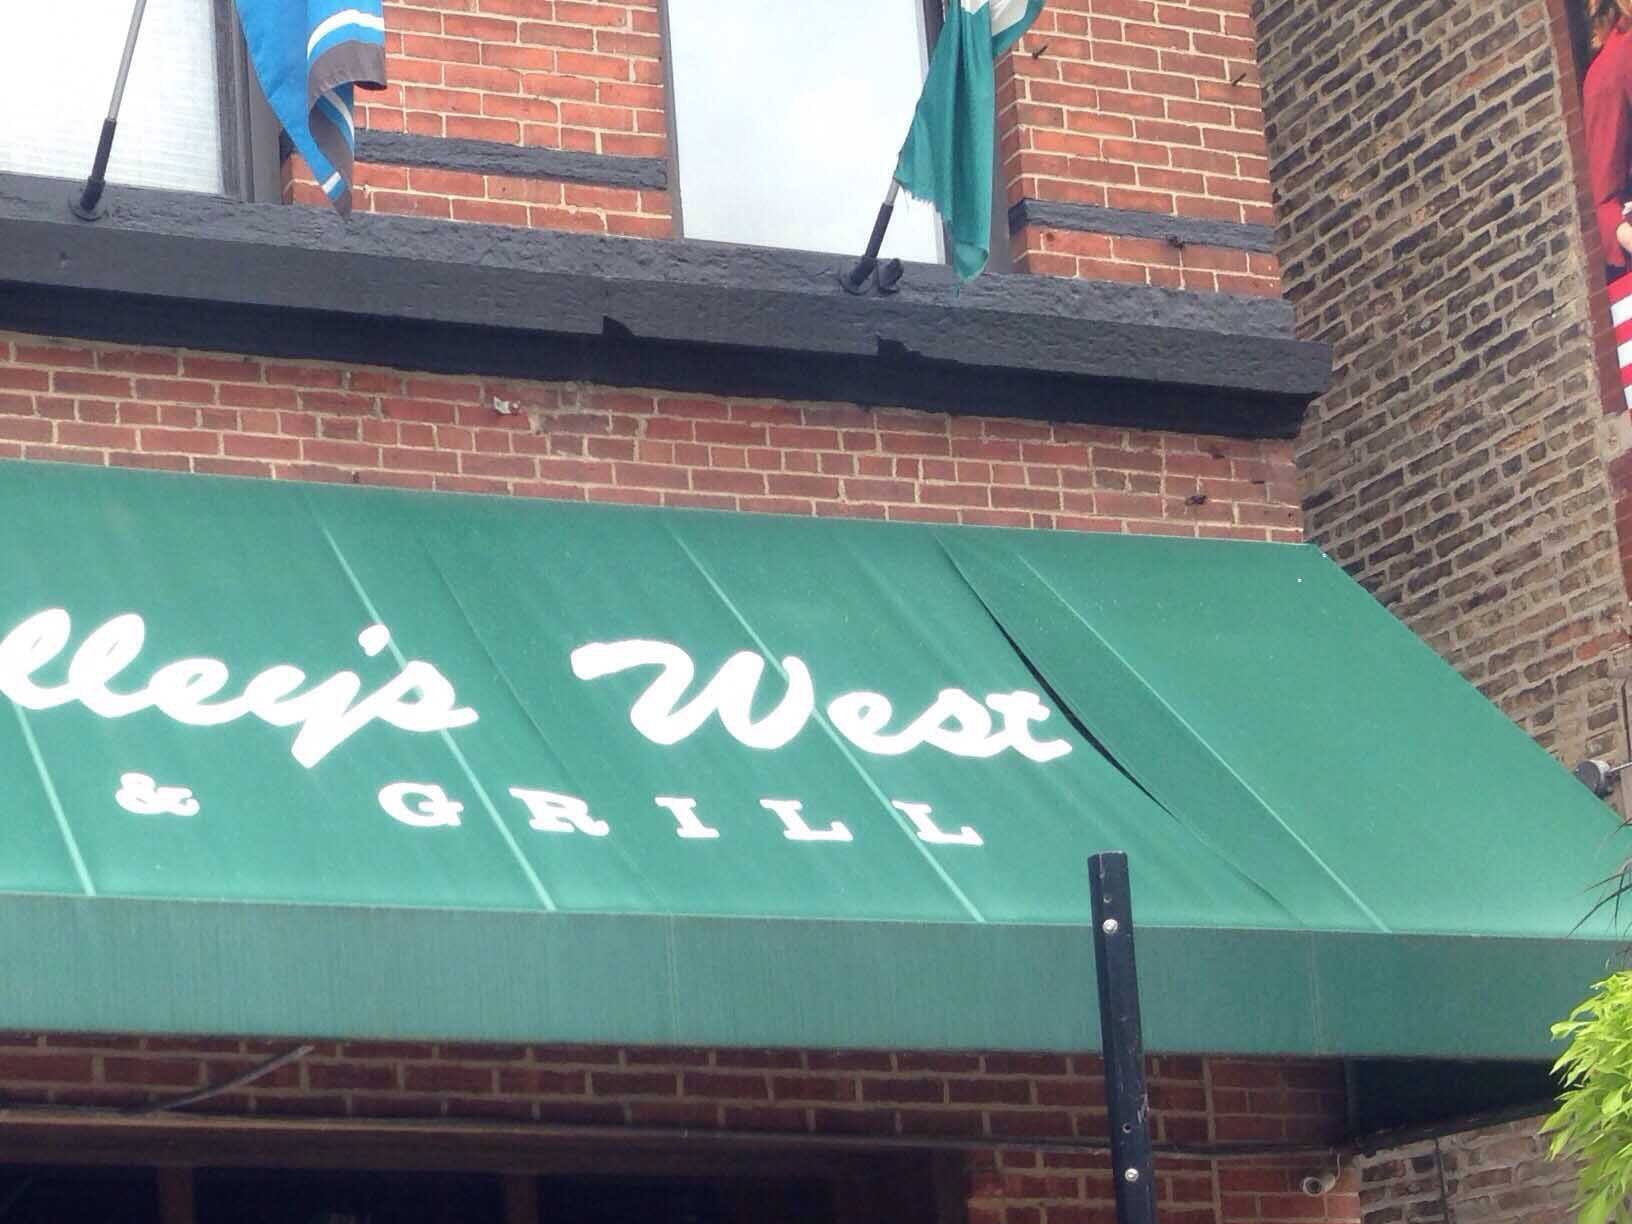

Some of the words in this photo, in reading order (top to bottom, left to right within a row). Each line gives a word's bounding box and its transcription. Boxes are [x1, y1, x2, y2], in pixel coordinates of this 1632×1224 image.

[569, 638, 1074, 763] West
[114, 771, 200, 817] &
[377, 781, 984, 846] GRILL
